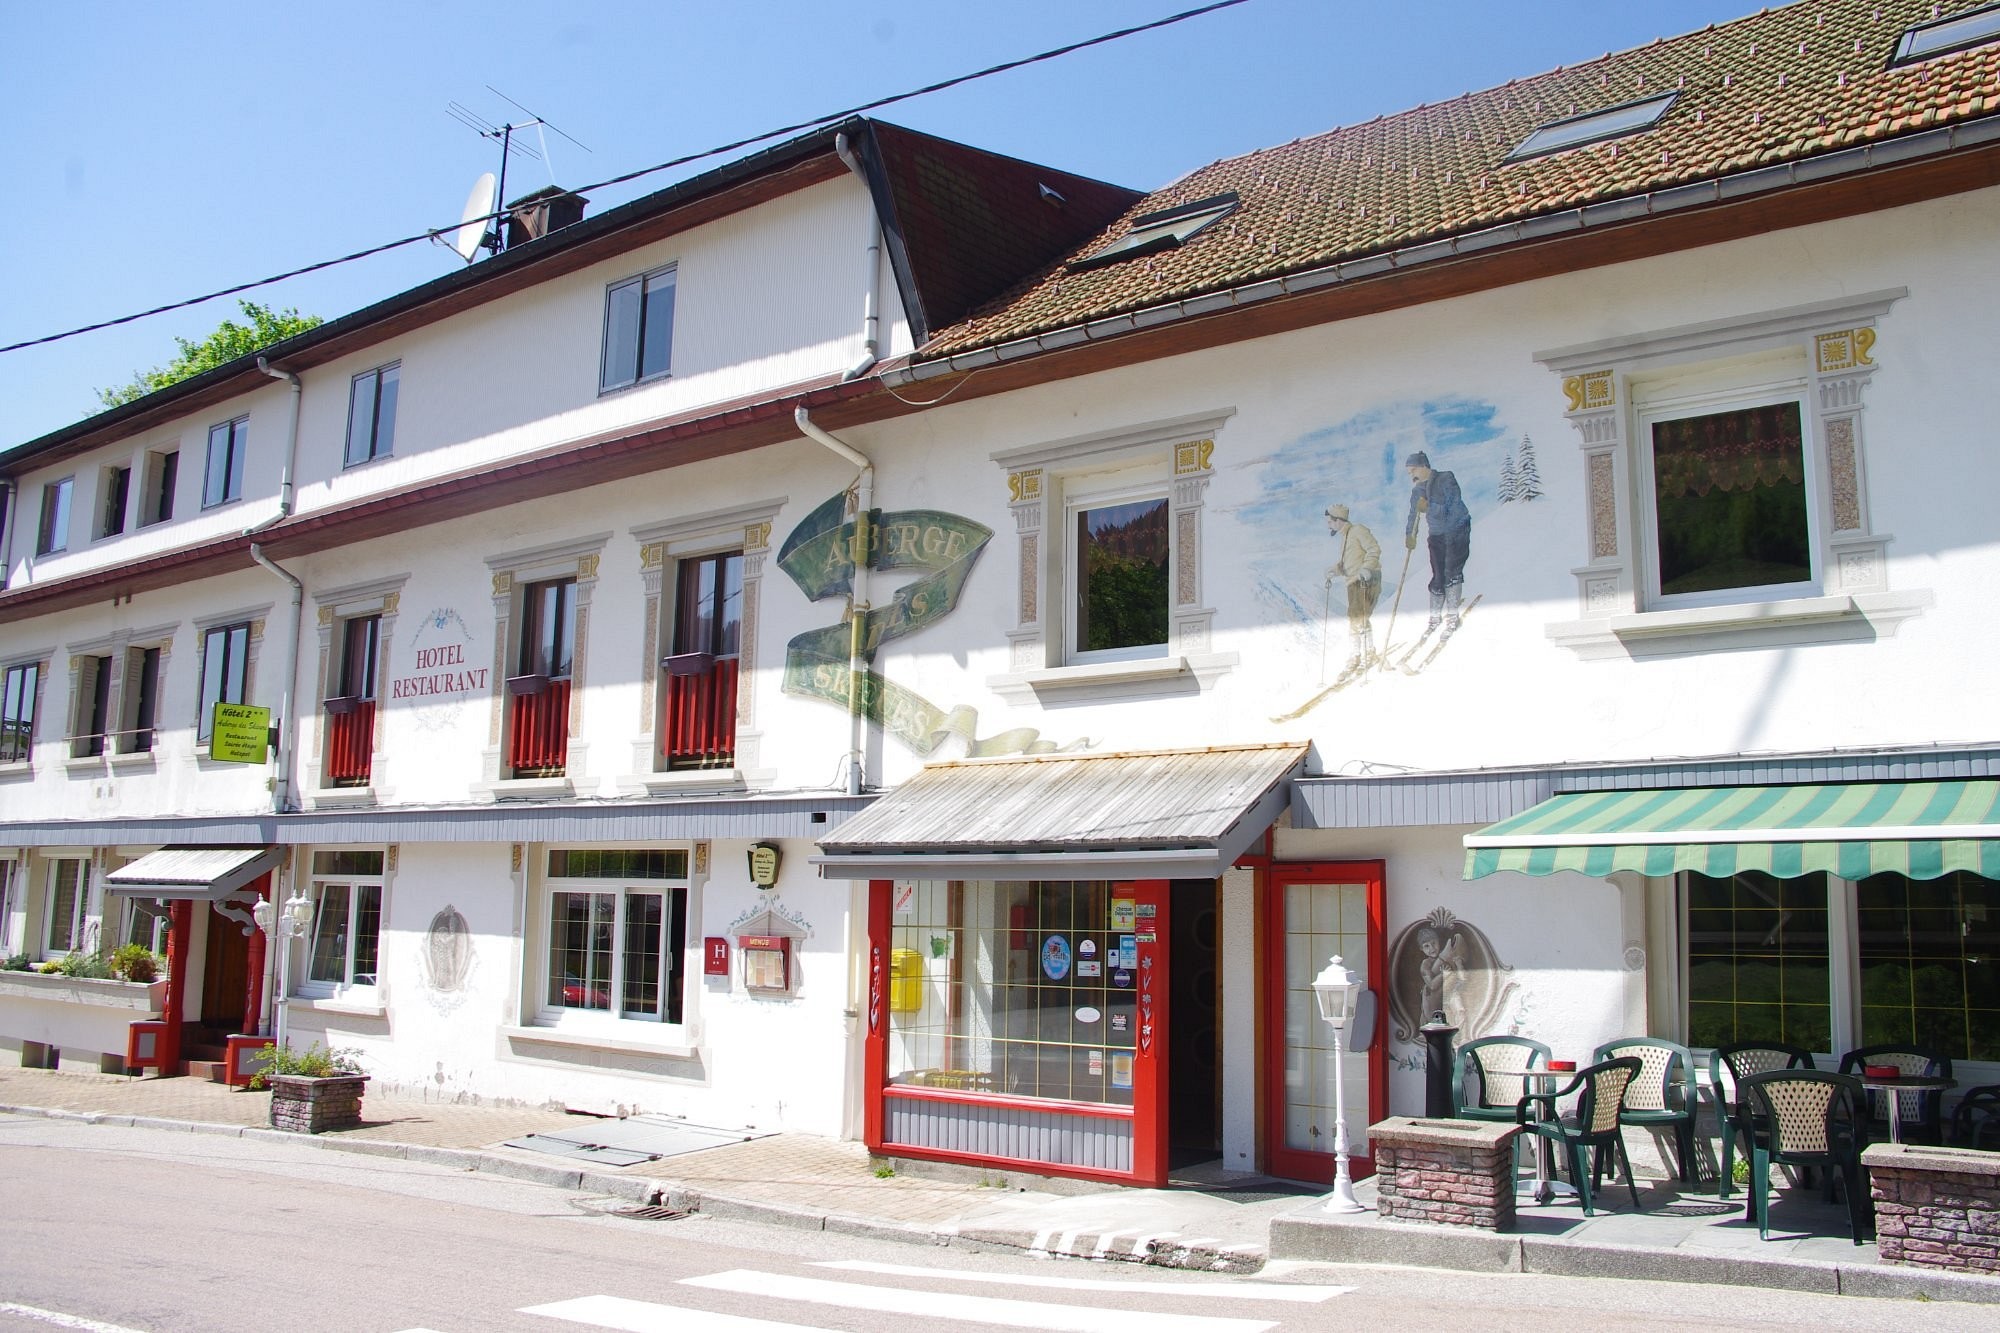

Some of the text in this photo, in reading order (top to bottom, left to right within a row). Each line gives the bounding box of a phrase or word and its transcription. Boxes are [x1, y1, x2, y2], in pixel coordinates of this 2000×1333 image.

[416, 644, 465, 669] HOTEL
[392, 668, 488, 699] RESTAURANT
[713, 944, 727, 959] H
